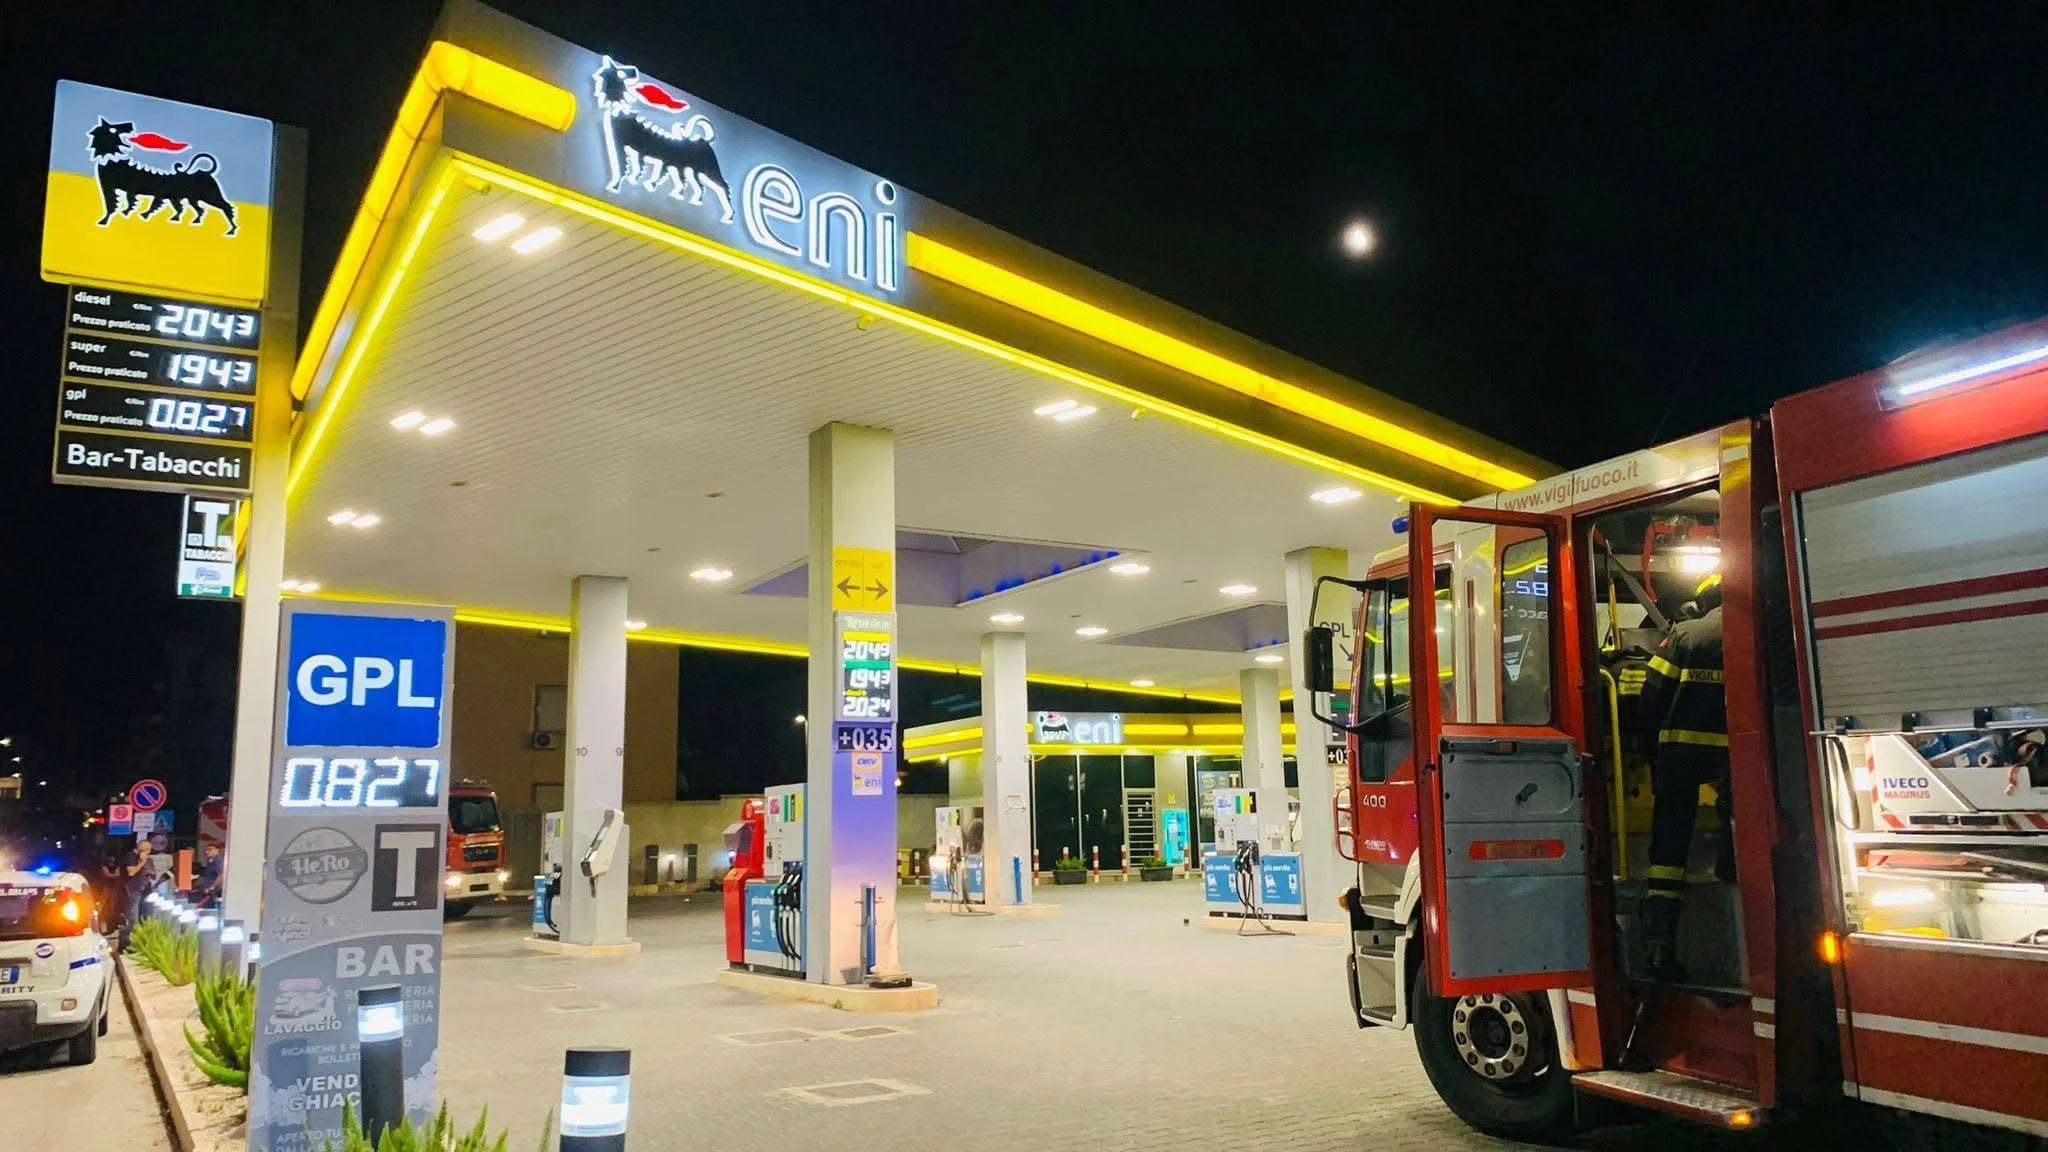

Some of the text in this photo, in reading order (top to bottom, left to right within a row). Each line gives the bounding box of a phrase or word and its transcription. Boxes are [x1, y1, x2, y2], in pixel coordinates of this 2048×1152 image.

[742, 163, 897, 291] eni
[74, 291, 111, 306] diesel
[72, 313, 151, 332] Prezzo praticato
[155, 304, 254, 340] 2043
[70, 341, 107, 353] super
[68, 361, 148, 379] Prezzo praticato
[167, 354, 252, 388] 1943
[65, 389, 87, 400] gpl
[64, 409, 144, 427] Prezzo praticato
[67, 443, 241, 478] Bar-Tabacchi
[296, 653, 435, 708] GPL
[1074, 713, 1121, 744] eni
[576, 747, 588, 757] 10
[615, 747, 623, 757] 9
[864, 779, 881, 787] eni
[1883, 777, 1929, 789] IVECO
[1363, 795, 1387, 808] 400
[1884, 790, 1931, 800] MAGIRUS
[380, 831, 436, 898] T
[336, 943, 435, 979] BAR
[264, 1020, 342, 1035] LAVAGGIO
[296, 1073, 359, 1092] VEND
[288, 1091, 361, 1111] GHIAC
